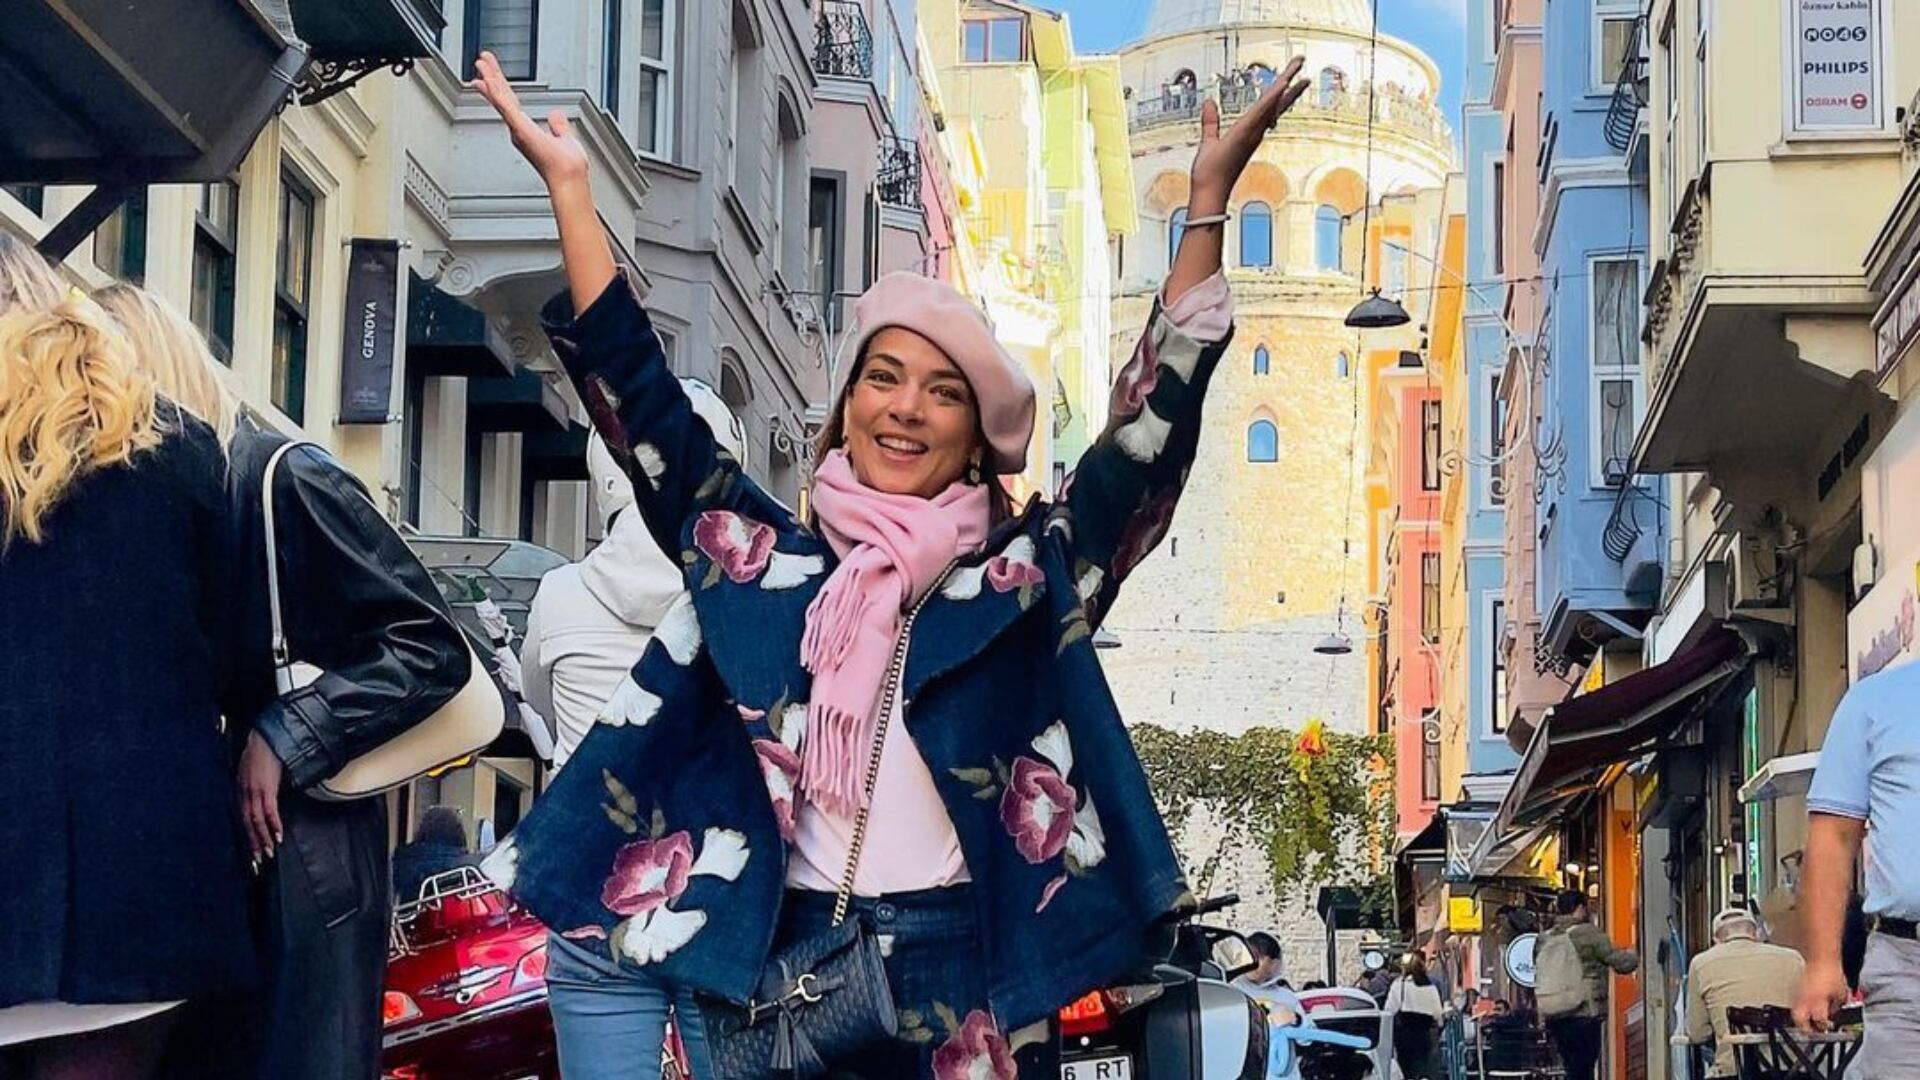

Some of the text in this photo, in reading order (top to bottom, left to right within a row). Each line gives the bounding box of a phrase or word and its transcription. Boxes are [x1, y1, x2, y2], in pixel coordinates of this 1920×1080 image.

[1804, 62, 1868, 74] PHILIPS
[1806, 97, 1848, 106] OSRAM
[362, 301, 377, 359] GENOVA
[1096, 1059, 1125, 1079] RT
